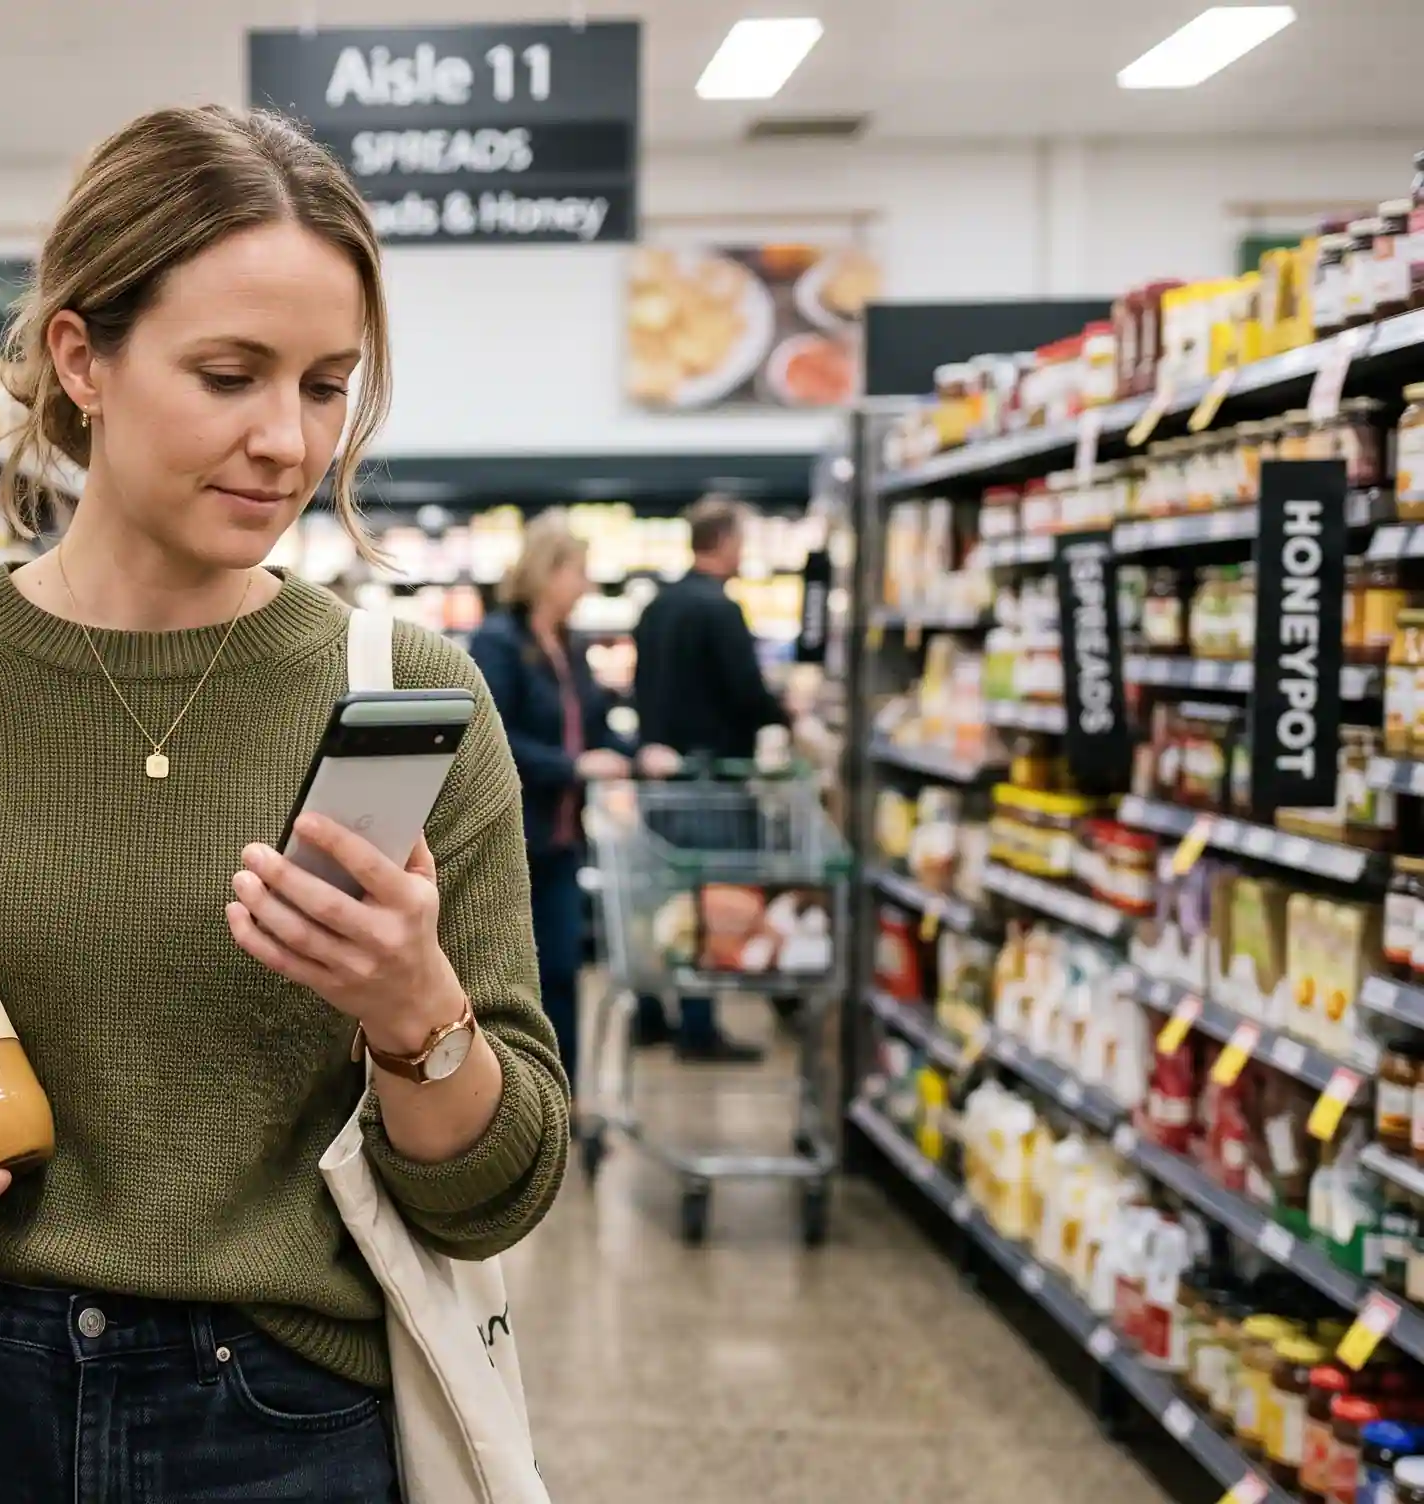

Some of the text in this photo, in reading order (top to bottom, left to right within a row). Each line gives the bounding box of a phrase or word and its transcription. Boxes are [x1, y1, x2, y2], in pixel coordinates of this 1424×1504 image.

[325, 42, 551, 107] Aisle 11
[351, 126, 534, 176] SPREADS
[375, 191, 440, 237] ads
[442, 189, 476, 236] &
[1276, 500, 1323, 780] HONEYPOT
